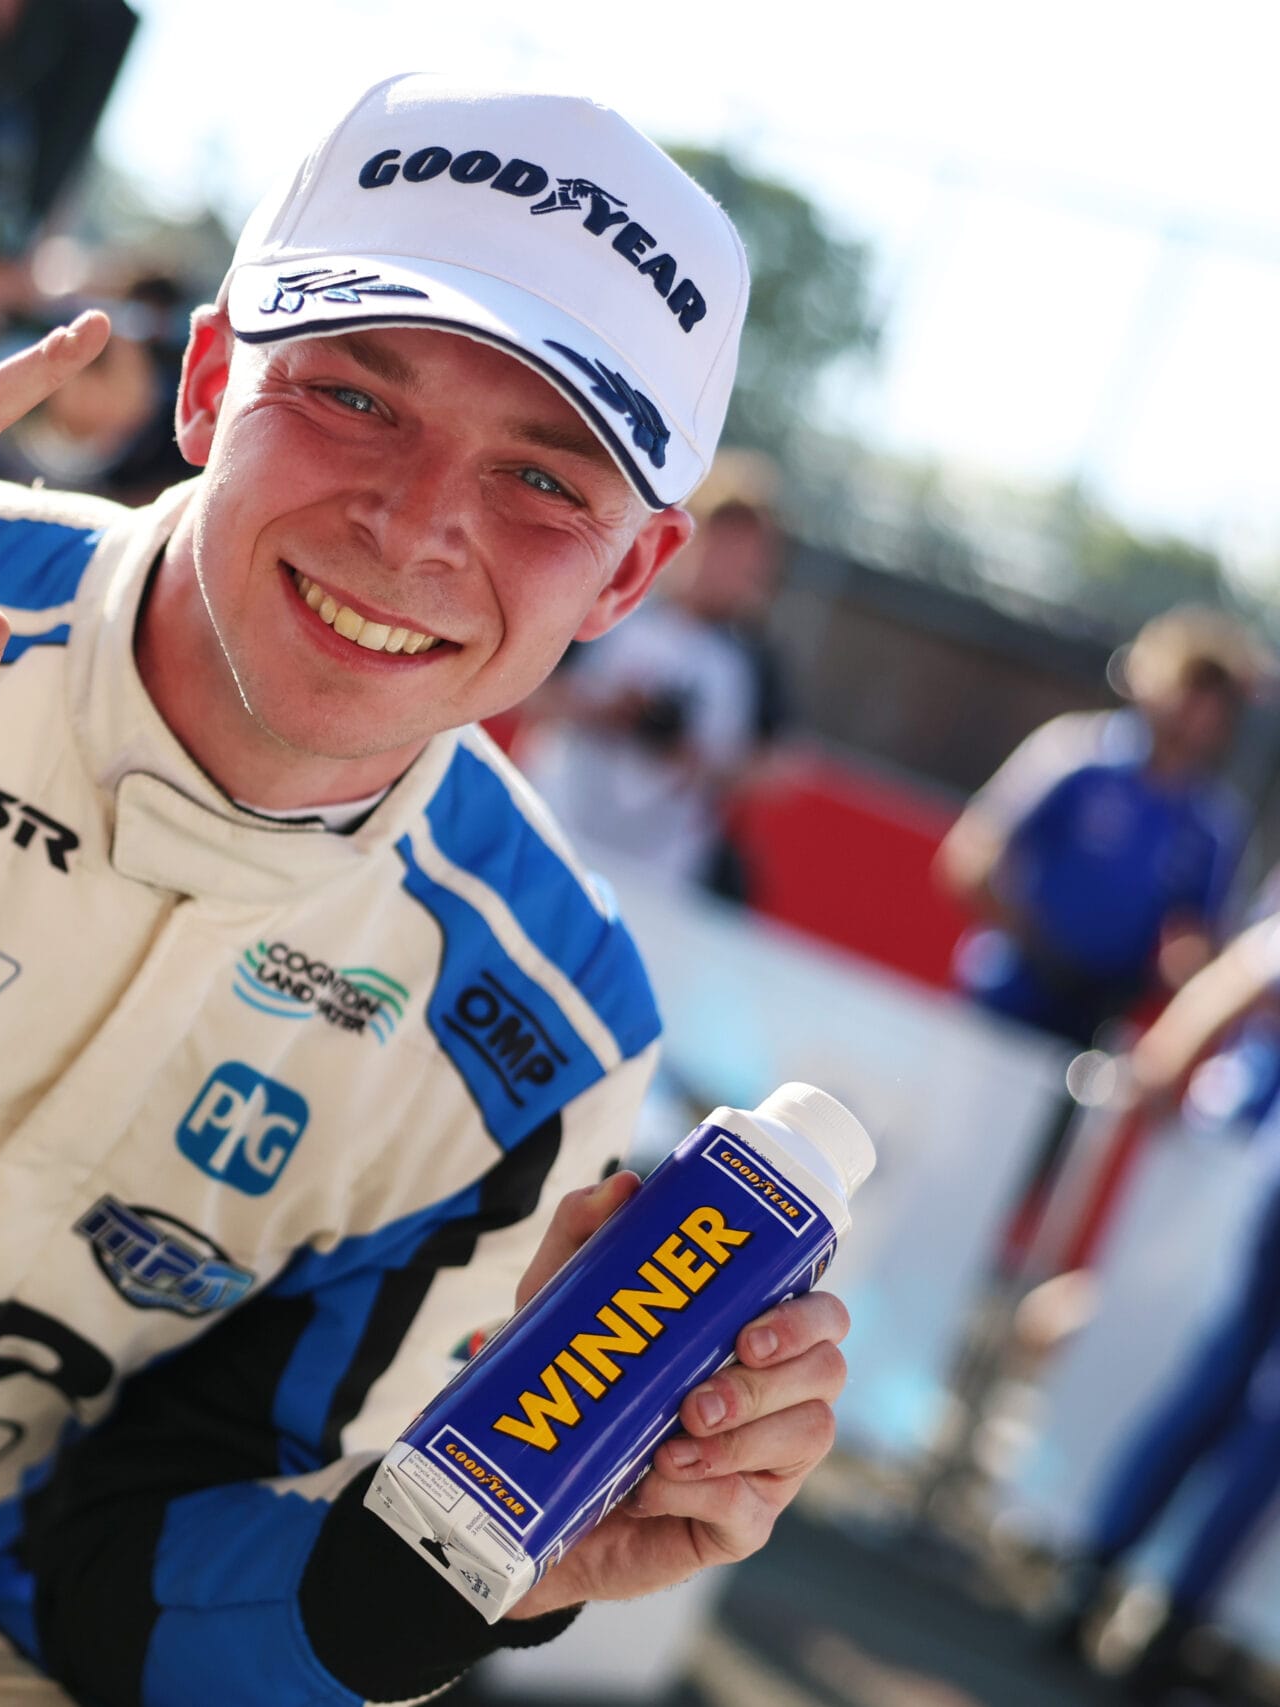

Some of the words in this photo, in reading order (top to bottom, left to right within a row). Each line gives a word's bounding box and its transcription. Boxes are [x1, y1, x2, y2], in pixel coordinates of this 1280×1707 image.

[359, 146, 707, 334] GOODYEAR
[456, 986, 556, 1087] OMP
[720, 1151, 800, 1218] GOODYEAR
[492, 1205, 751, 1454] WINNER
[445, 1443, 526, 1516] GOODYEAR
